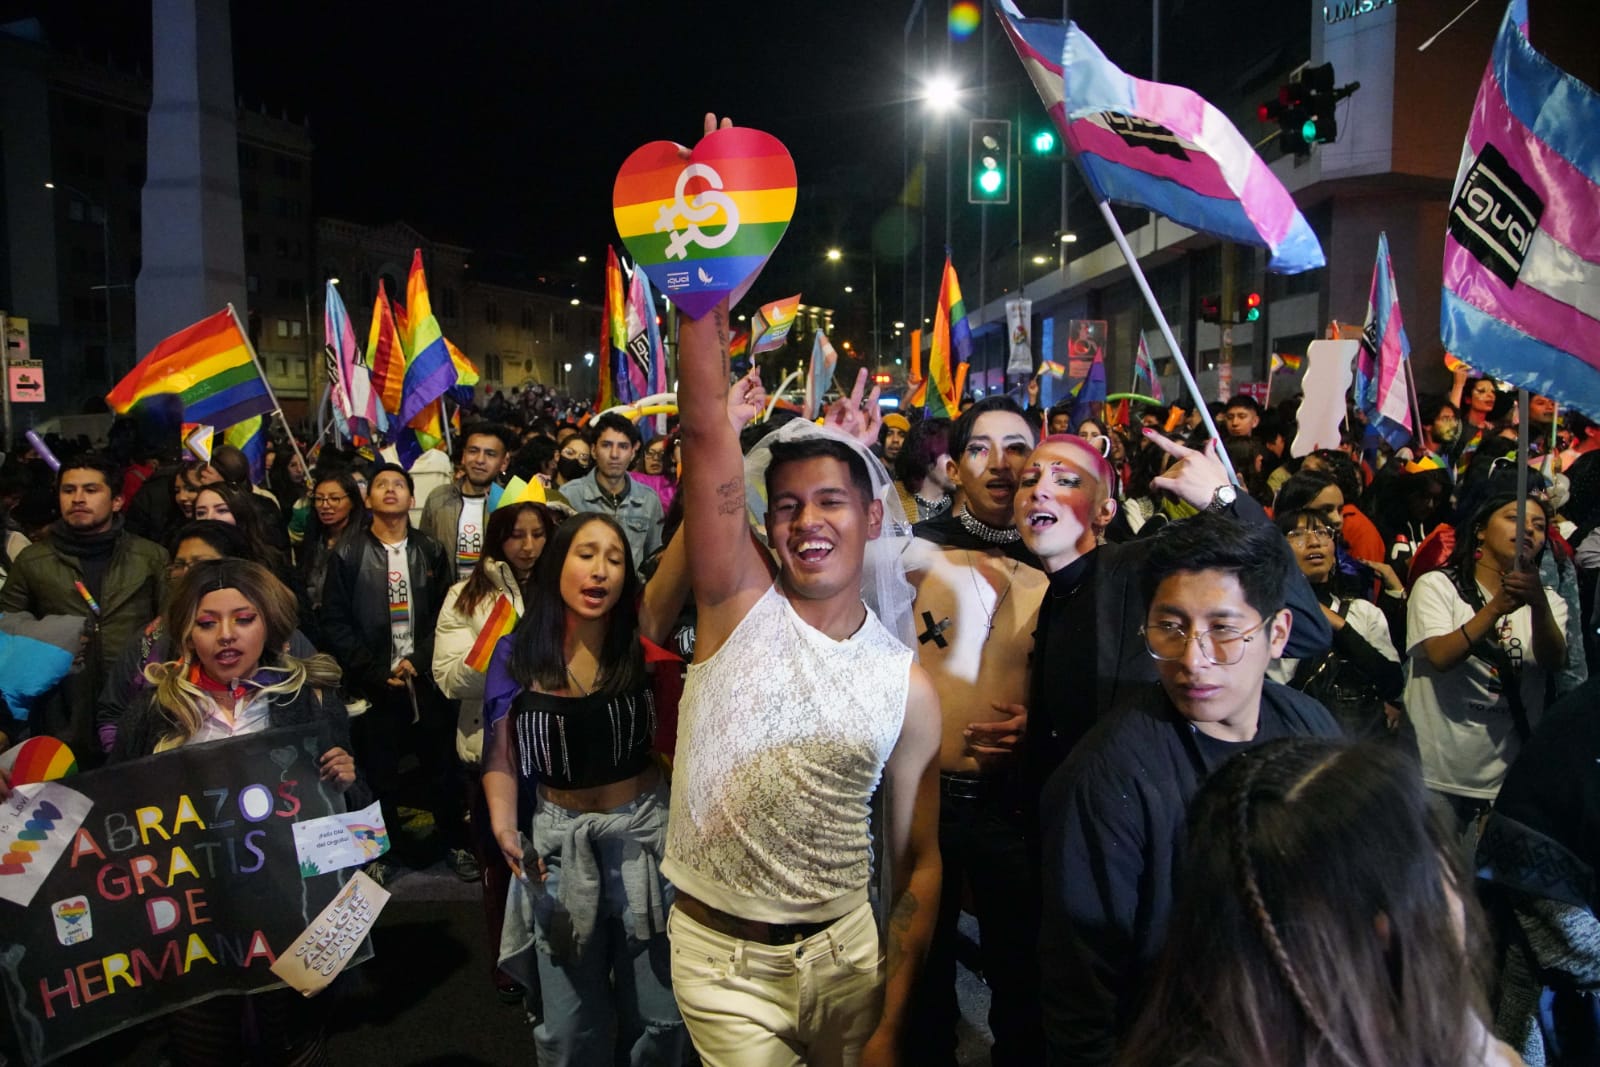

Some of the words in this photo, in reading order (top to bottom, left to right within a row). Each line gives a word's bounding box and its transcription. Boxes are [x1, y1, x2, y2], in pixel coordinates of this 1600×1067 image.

[70, 780, 302, 868] ABRAZOS
[97, 829, 267, 901] GRATIS
[145, 888, 212, 935] DE
[39, 930, 277, 1019] HERMANA
